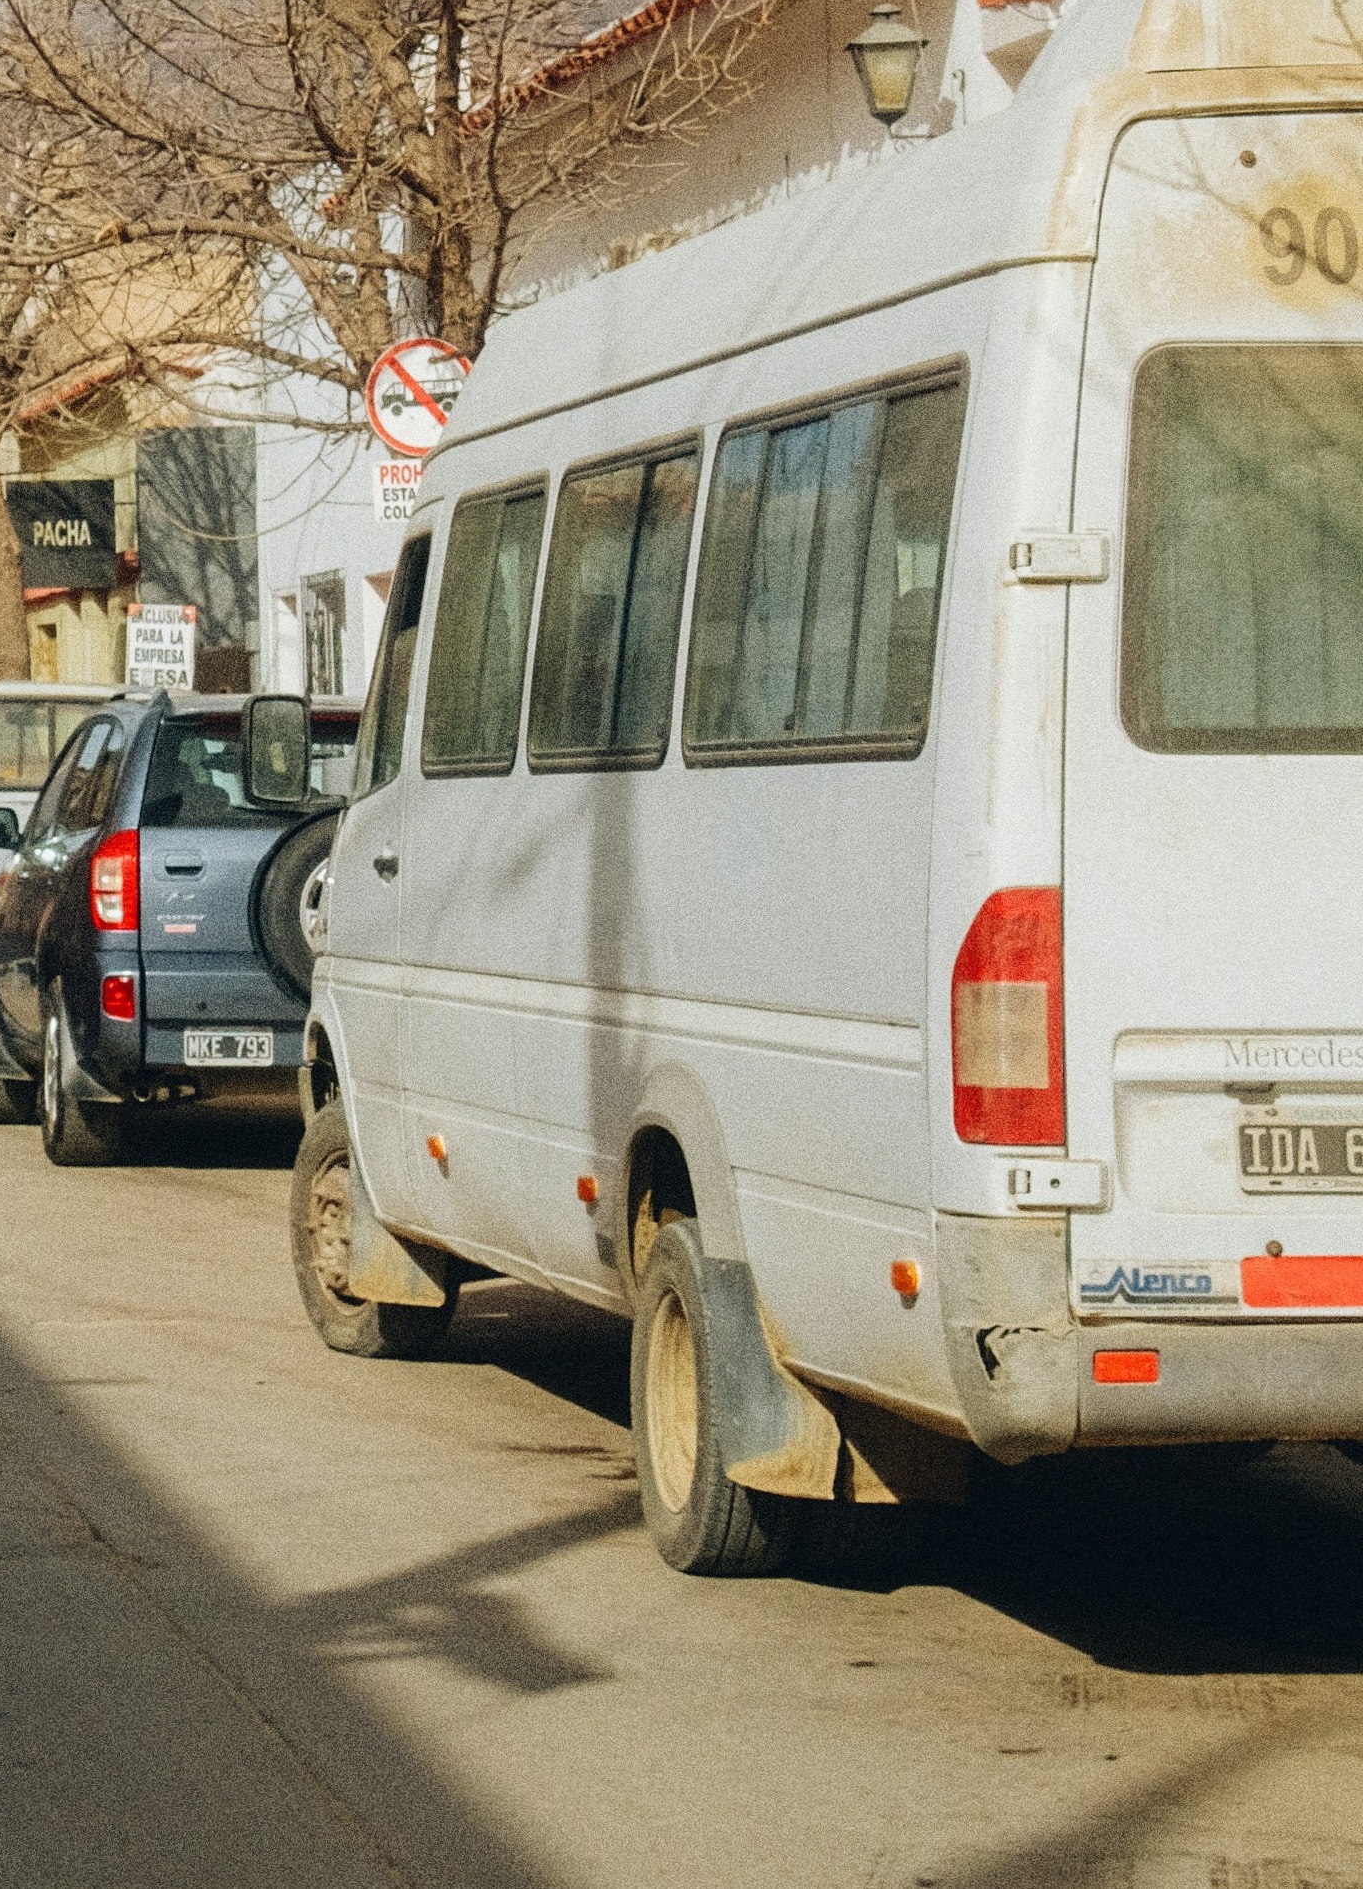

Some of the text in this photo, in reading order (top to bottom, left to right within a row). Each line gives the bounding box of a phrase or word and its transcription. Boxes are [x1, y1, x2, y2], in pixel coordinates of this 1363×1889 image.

[1259, 207, 1358, 286] 90
[32, 519, 92, 547] PACHA
[136, 628, 184, 645] PARA LA
[134, 647, 185, 665] EMPRESA
[129, 667, 190, 688] EESA
[235, 1036, 270, 1060] 793
[1224, 1038, 1363, 1069] Mercedes
[1244, 1127, 1321, 1174] IDA
